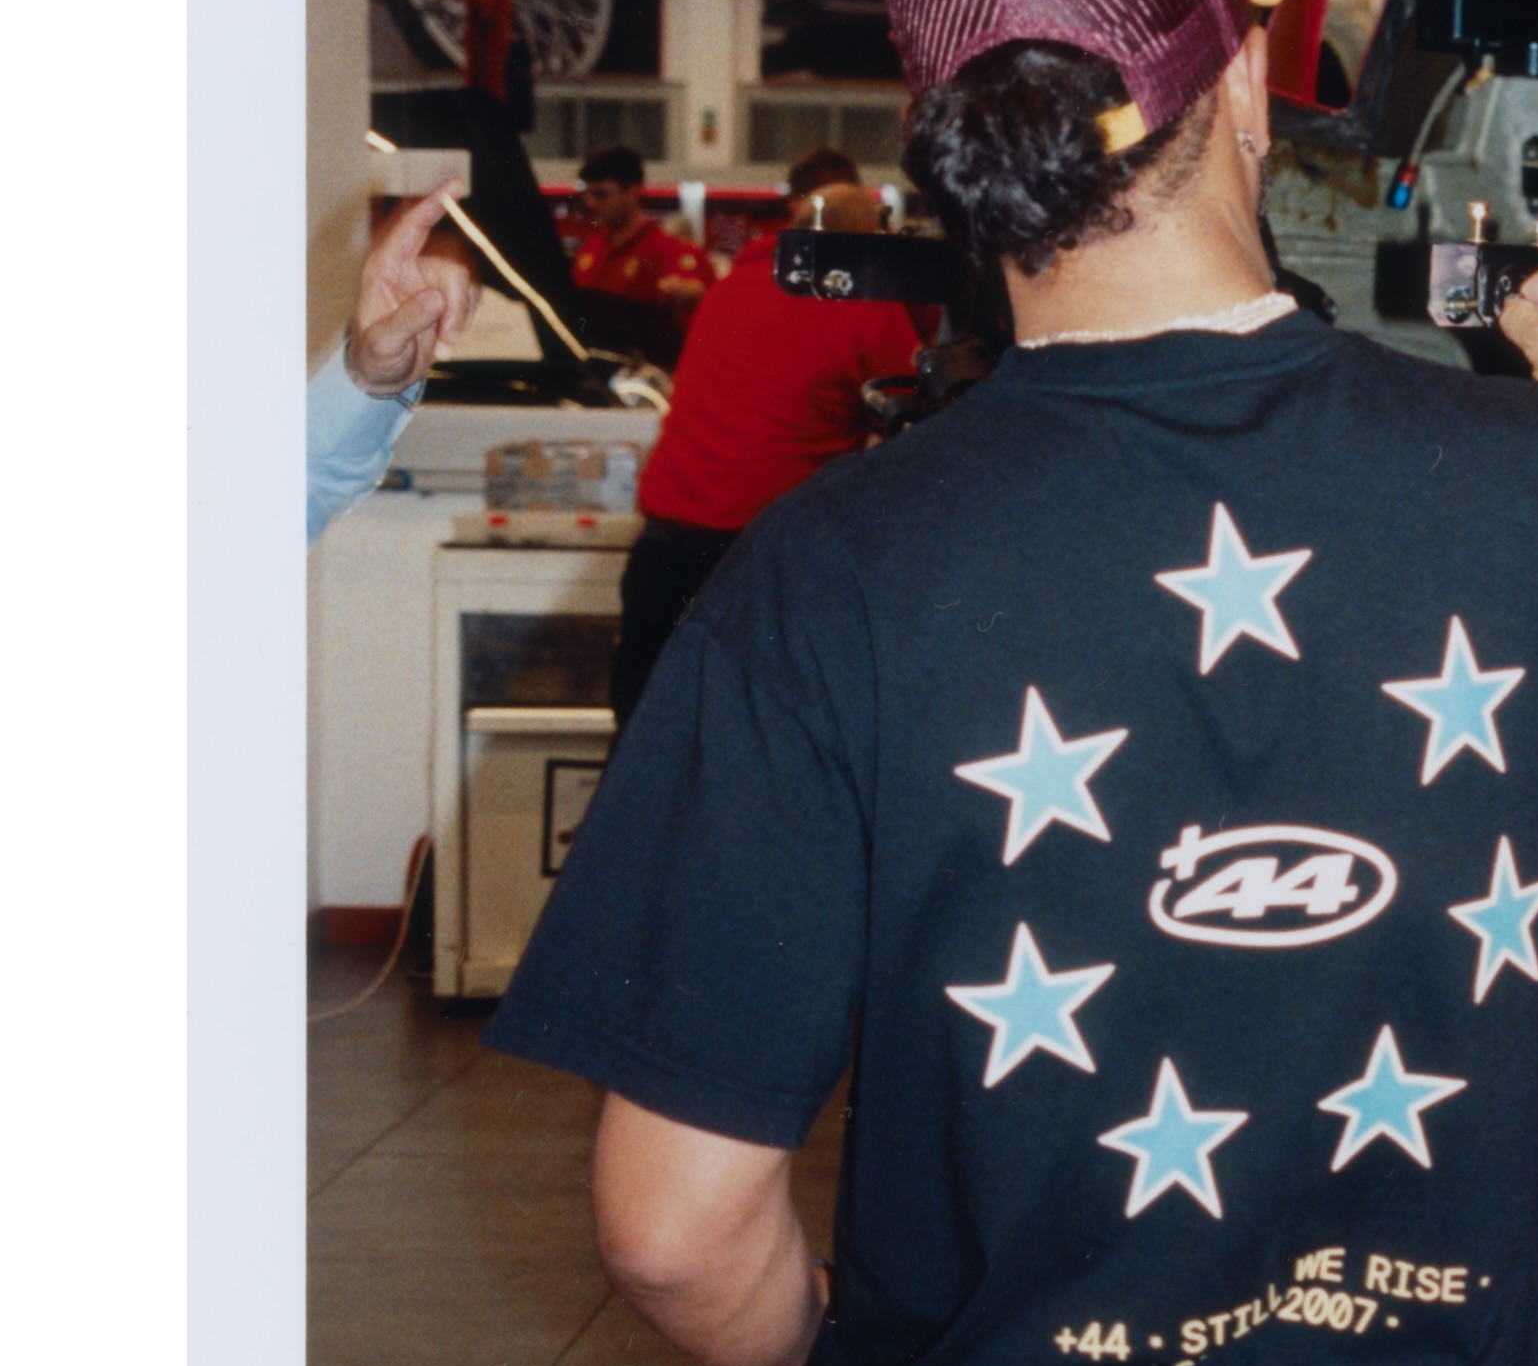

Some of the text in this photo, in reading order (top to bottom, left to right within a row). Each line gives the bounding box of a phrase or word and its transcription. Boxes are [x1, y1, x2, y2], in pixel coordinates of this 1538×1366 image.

[1055, 1247, 1467, 1361] +44 STILL WE RISE
[1277, 1286, 1378, 1334] 2007
